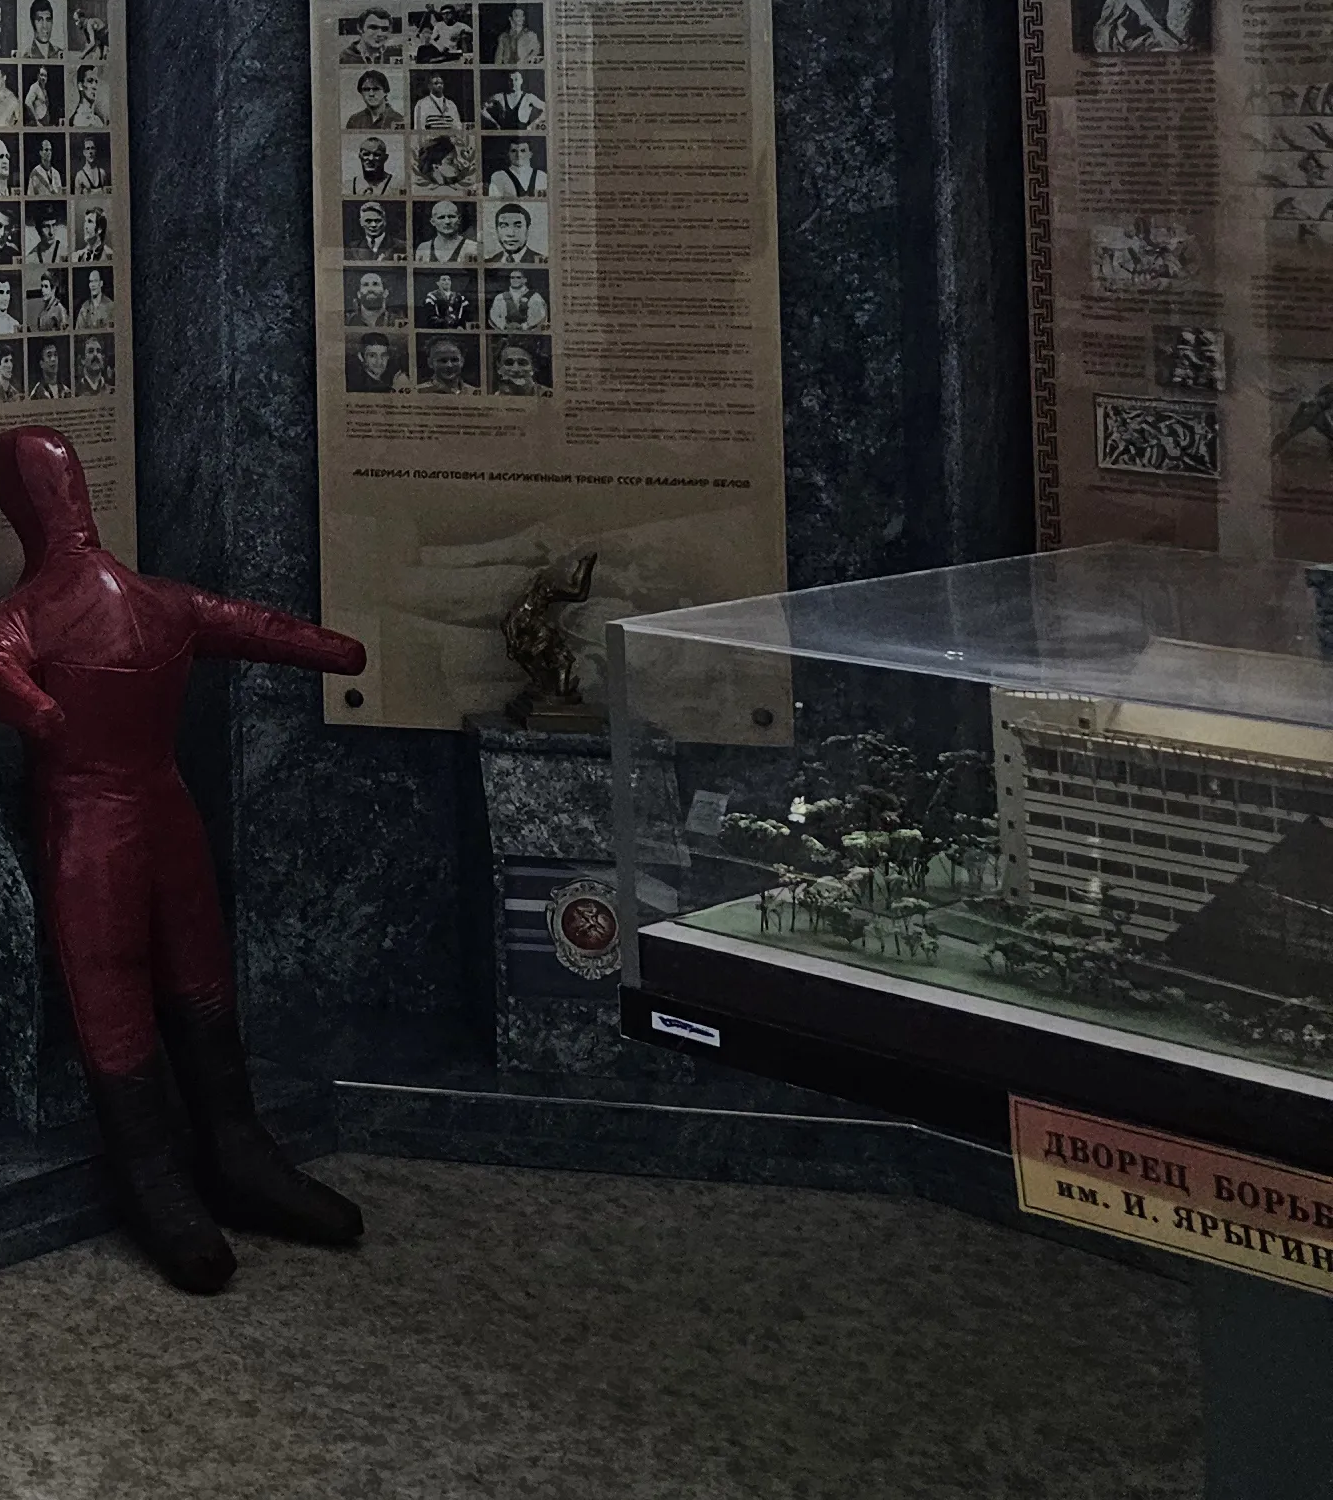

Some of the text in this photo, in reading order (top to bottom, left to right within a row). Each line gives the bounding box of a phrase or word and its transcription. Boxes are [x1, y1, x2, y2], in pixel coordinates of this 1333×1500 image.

[353, 468, 410, 478] МАТЕРИАЛ
[412, 470, 485, 481] ПОДГОТОВИЛ
[575, 474, 614, 485] ТРЕНЕР
[617, 476, 643, 485] СССР
[645, 477, 710, 487] ВЛАДИМИР
[713, 478, 751, 488] БЕЛОВ
[1044, 1131, 1191, 1196] ДВОРЕЦ
[1056, 1180, 1333, 1273] им. И. ЯРЫГИН
